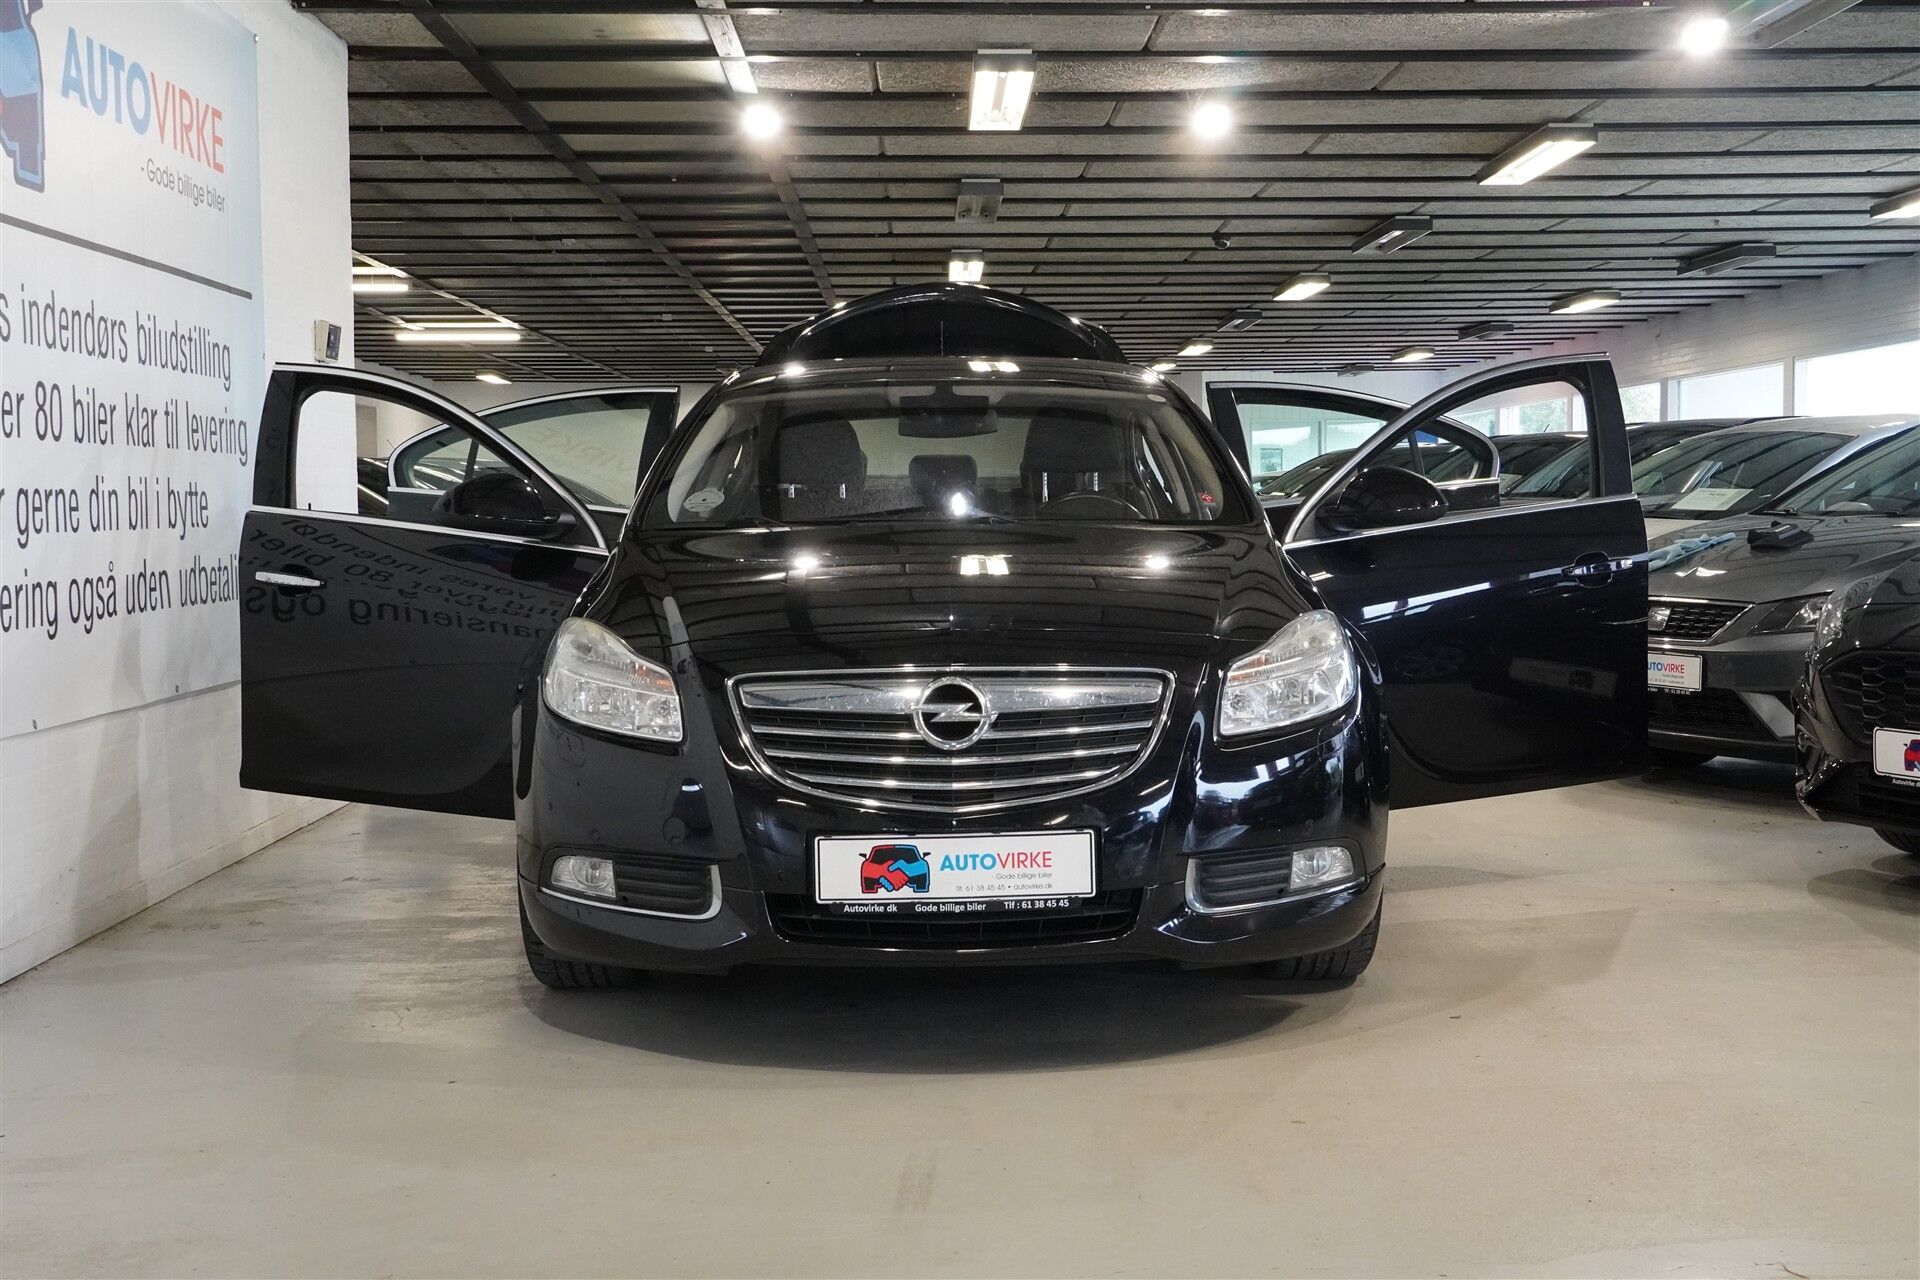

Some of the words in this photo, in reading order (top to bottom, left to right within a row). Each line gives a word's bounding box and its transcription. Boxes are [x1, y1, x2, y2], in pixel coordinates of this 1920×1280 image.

[61, 26, 225, 174] AUTOVIRKE
[146, 158, 176, 191] Gode
[177, 167, 205, 207] billige
[206, 188, 225, 213] biler
[21, 283, 128, 363] indendørs
[136, 310, 231, 391] biludstilling
[35, 380, 63, 442] 80
[72, 385, 116, 446] biler
[125, 392, 158, 448] klar
[164, 399, 179, 451] til
[186, 400, 248, 466] levering
[16, 487, 80, 549] gerne
[88, 475, 119, 533] din
[128, 476, 149, 531] bil
[155, 477, 160, 529] i
[168, 477, 209, 540] bytte
[68, 560, 118, 634] også
[125, 559, 171, 615] uden
[1648, 661, 1685, 674] UTOVIRKE
[939, 851, 1052, 871] AUTOVIRKE
[843, 903, 885, 912] Autovirke
[915, 903, 938, 912] Gode
[939, 903, 965, 913] billige
[966, 902, 986, 911] biler
[1021, 900, 1033, 909] 61
[1034, 900, 1045, 908] 38
[1046, 899, 1057, 908] 45
[1058, 899, 1070, 907] 45
